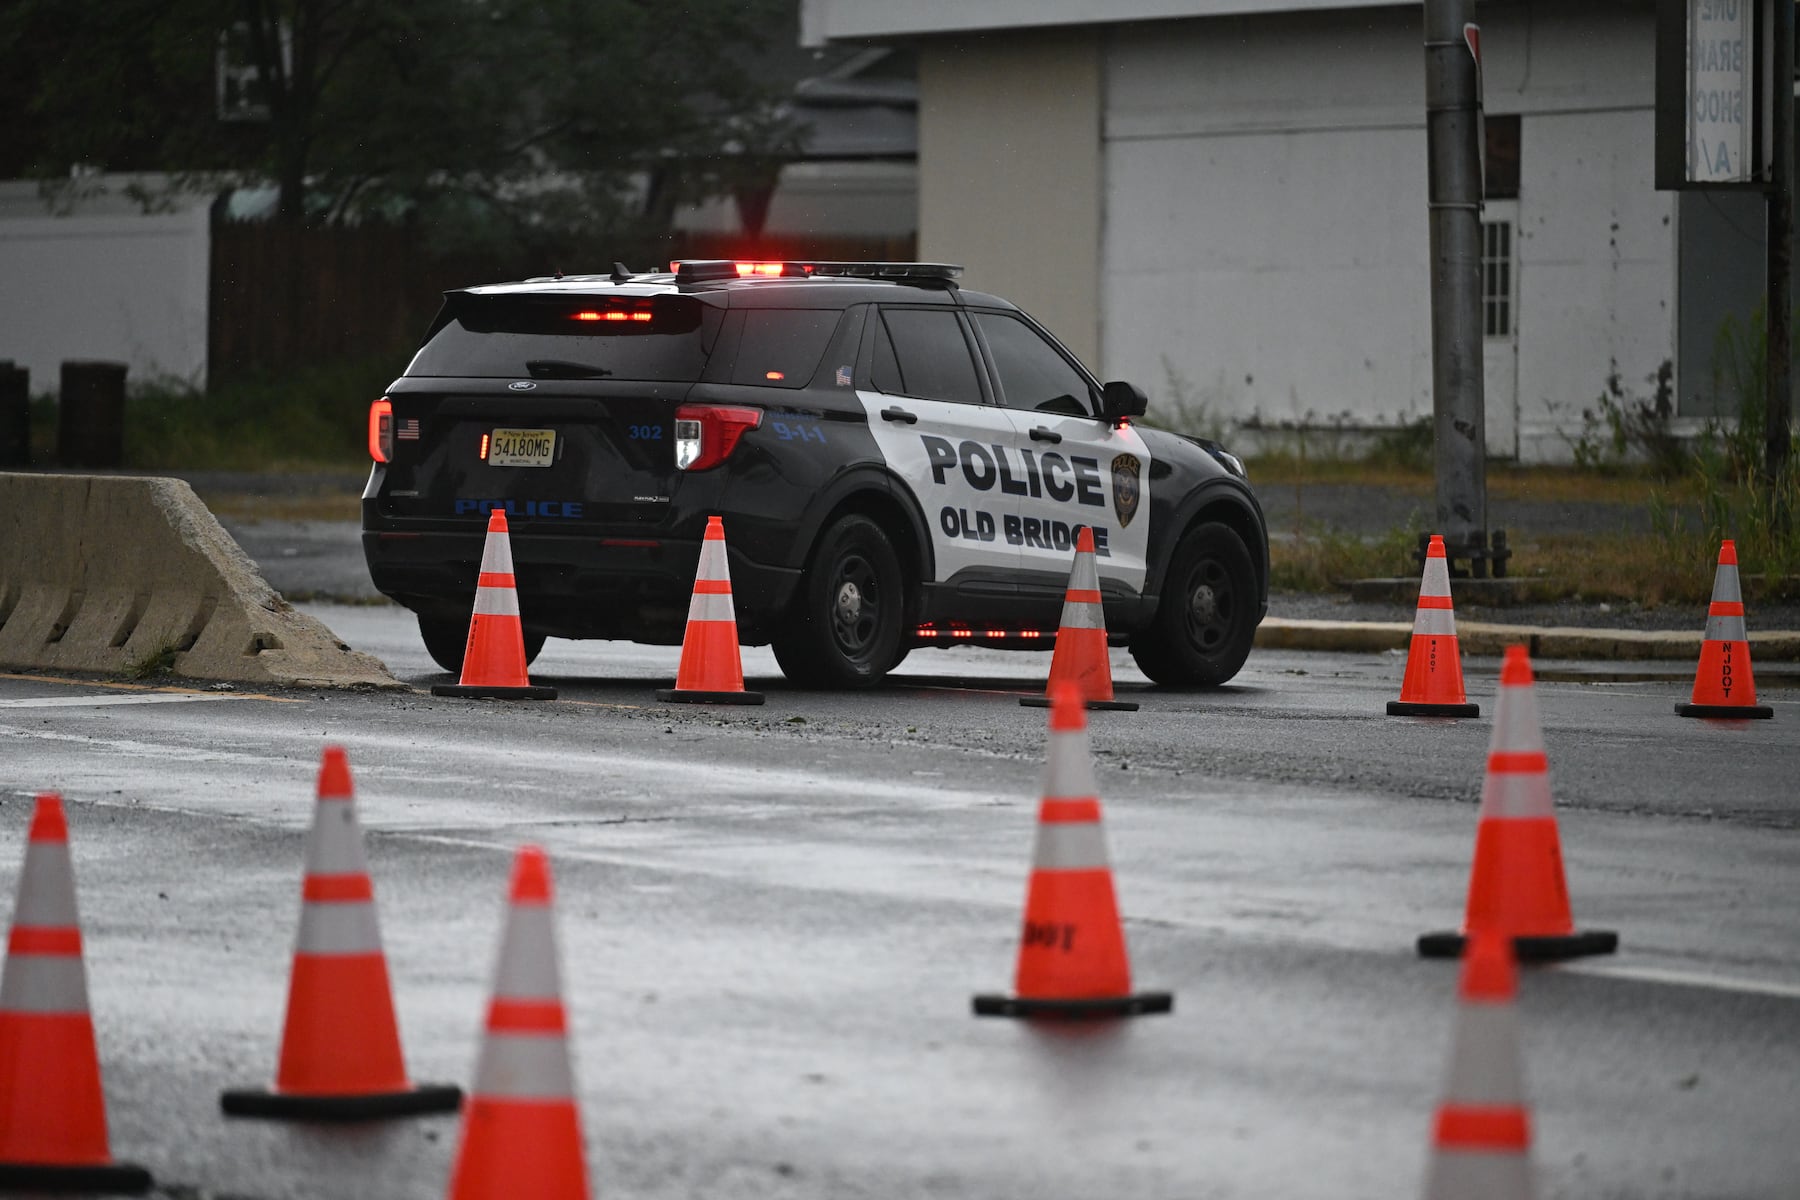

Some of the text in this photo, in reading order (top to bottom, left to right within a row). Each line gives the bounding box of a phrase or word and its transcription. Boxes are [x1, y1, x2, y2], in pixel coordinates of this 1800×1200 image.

[629, 425, 662, 440] 302
[772, 421, 827, 443] 9-1-1
[920, 435, 1105, 507] POLICE
[455, 498, 583, 517] POLICE
[940, 506, 995, 542] OLD
[1722, 642, 1732, 699] NJDOT
